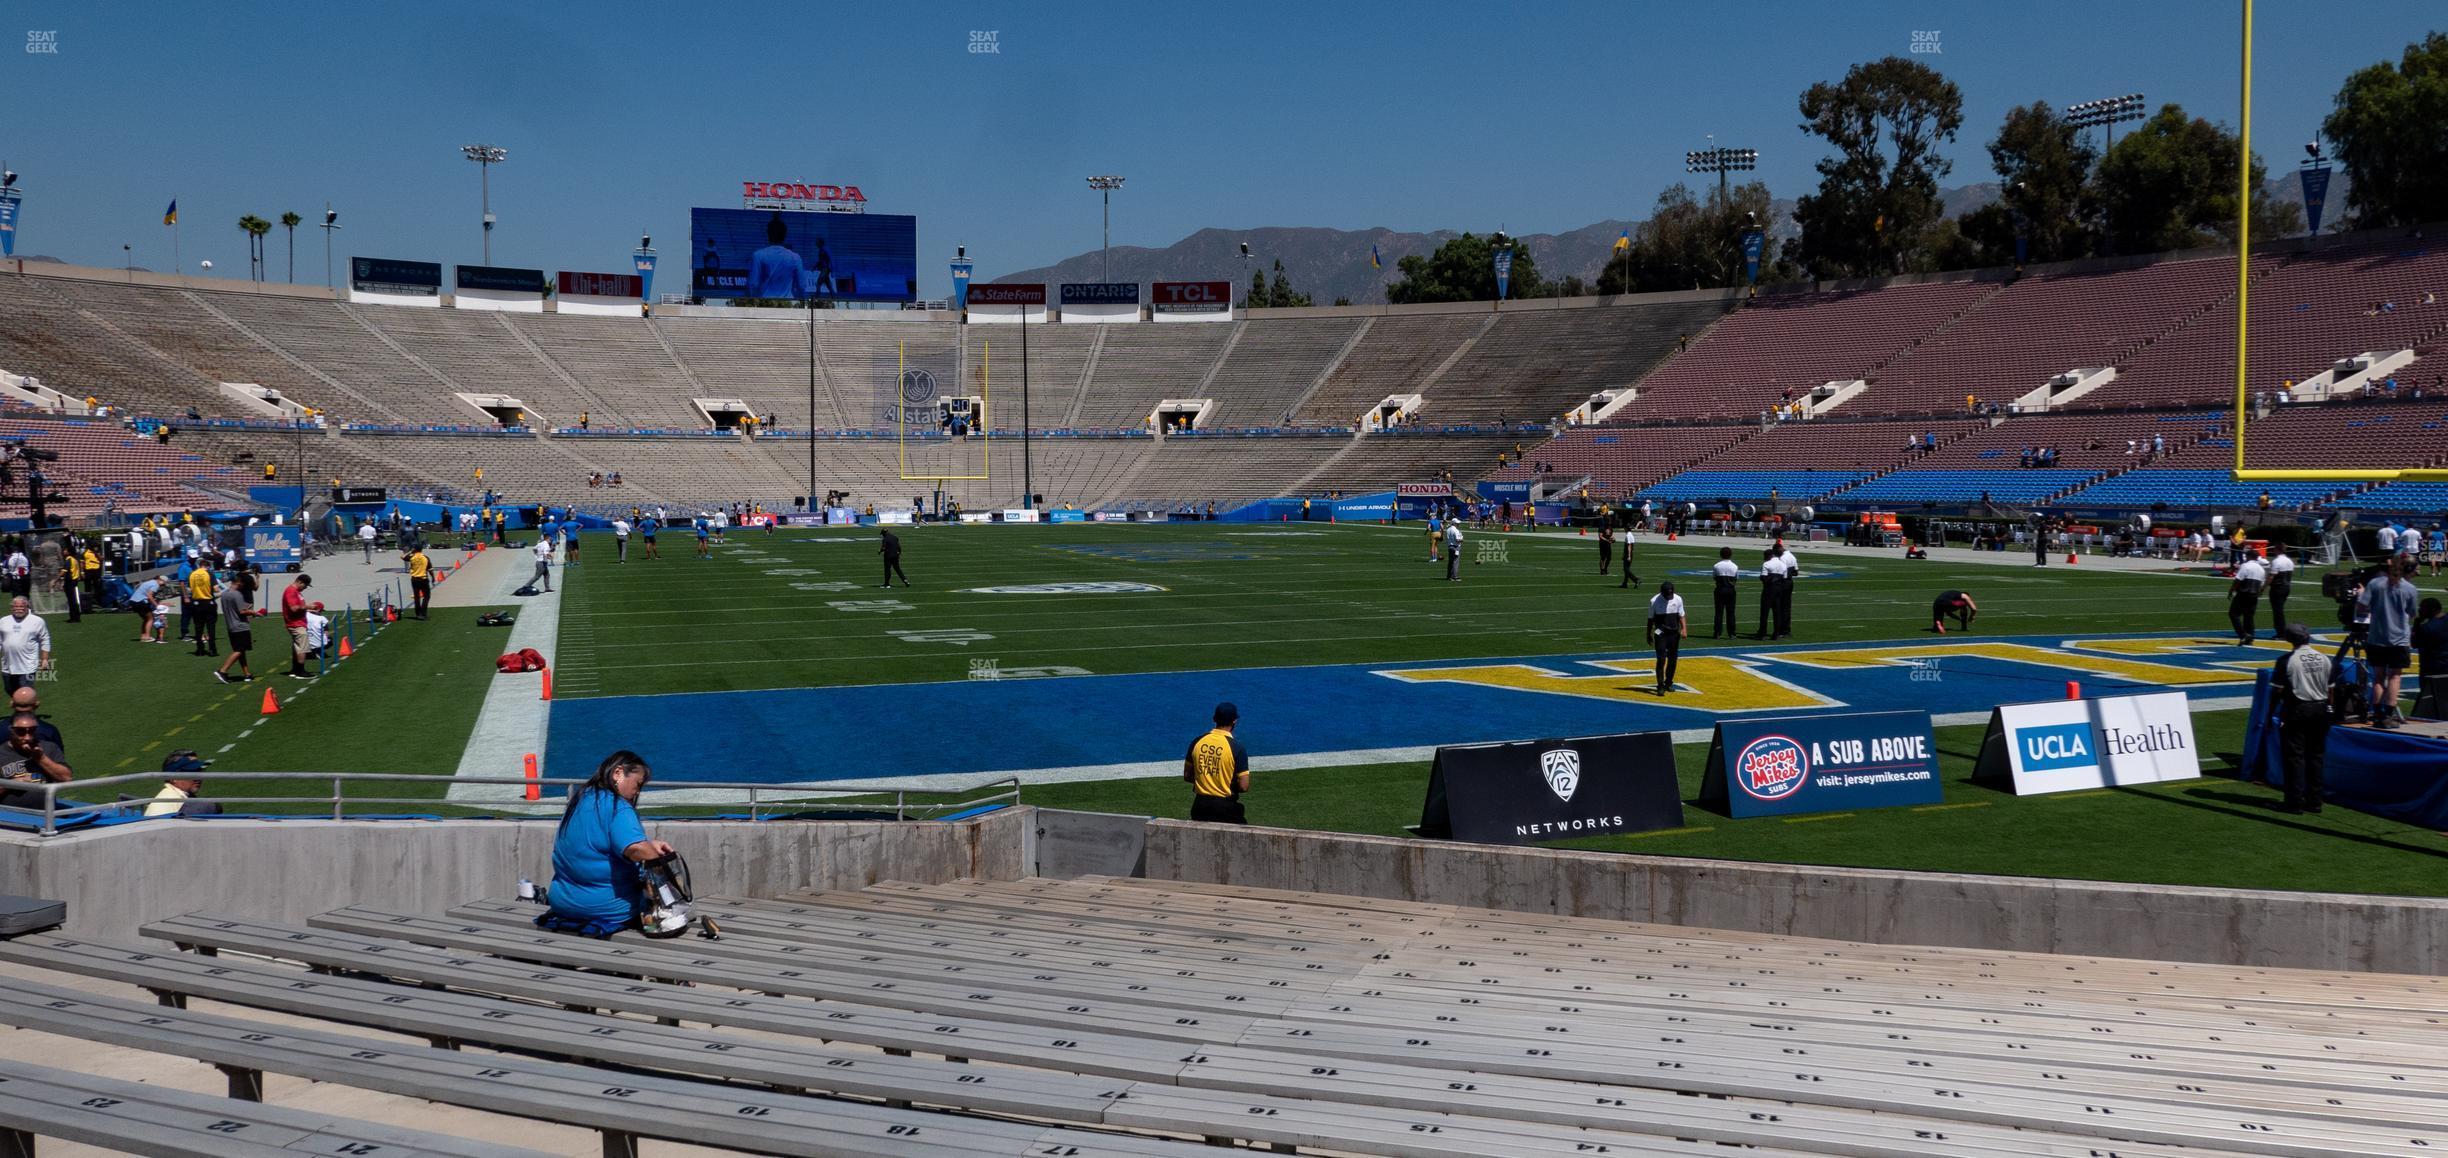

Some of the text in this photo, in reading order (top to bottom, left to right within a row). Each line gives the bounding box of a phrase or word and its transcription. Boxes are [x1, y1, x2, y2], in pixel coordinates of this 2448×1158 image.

[744, 182, 867, 201] HONDA
[1166, 285, 1217, 301] TCL
[884, 404, 948, 424] Allstate
[1399, 484, 1451, 494] HONDA
[2300, 653, 2322, 662] CSC
[2027, 723, 2186, 761] UCLA Health
[1200, 744, 1224, 756] CSC
[1812, 736, 1932, 766] A SUB ABOVE.
[1198, 754, 1221, 767] EVENT
[1543, 751, 1578, 778] PAC
[1745, 748, 1796, 771] Jersey
[1198, 764, 1220, 776] STAFF
[1752, 762, 1799, 789] Mike's
[1556, 777, 1572, 792] 12
[1816, 770, 1931, 787] visit: jerseymikes.com
[1768, 784, 1788, 794] SUBS
[1516, 815, 1624, 836] NETWORKS
[382, 995, 412, 1003] 23
[482, 1010, 514, 1018] 22
[240, 1034, 276, 1042] 23
[350, 1050, 383, 1060] 22
[476, 1070, 512, 1078] 21
[602, 1088, 640, 1098] 20
[1097, 1090, 1132, 1100] 17
[81, 1098, 124, 1108] 23
[738, 1106, 771, 1116] 19
[206, 1120, 250, 1133] 22
[886, 1124, 920, 1136] 18
[1410, 1125, 1442, 1133] 15
[336, 1142, 380, 1156] 21
[1042, 1146, 1080, 1157] 17
[1576, 1144, 1610, 1152] 14
